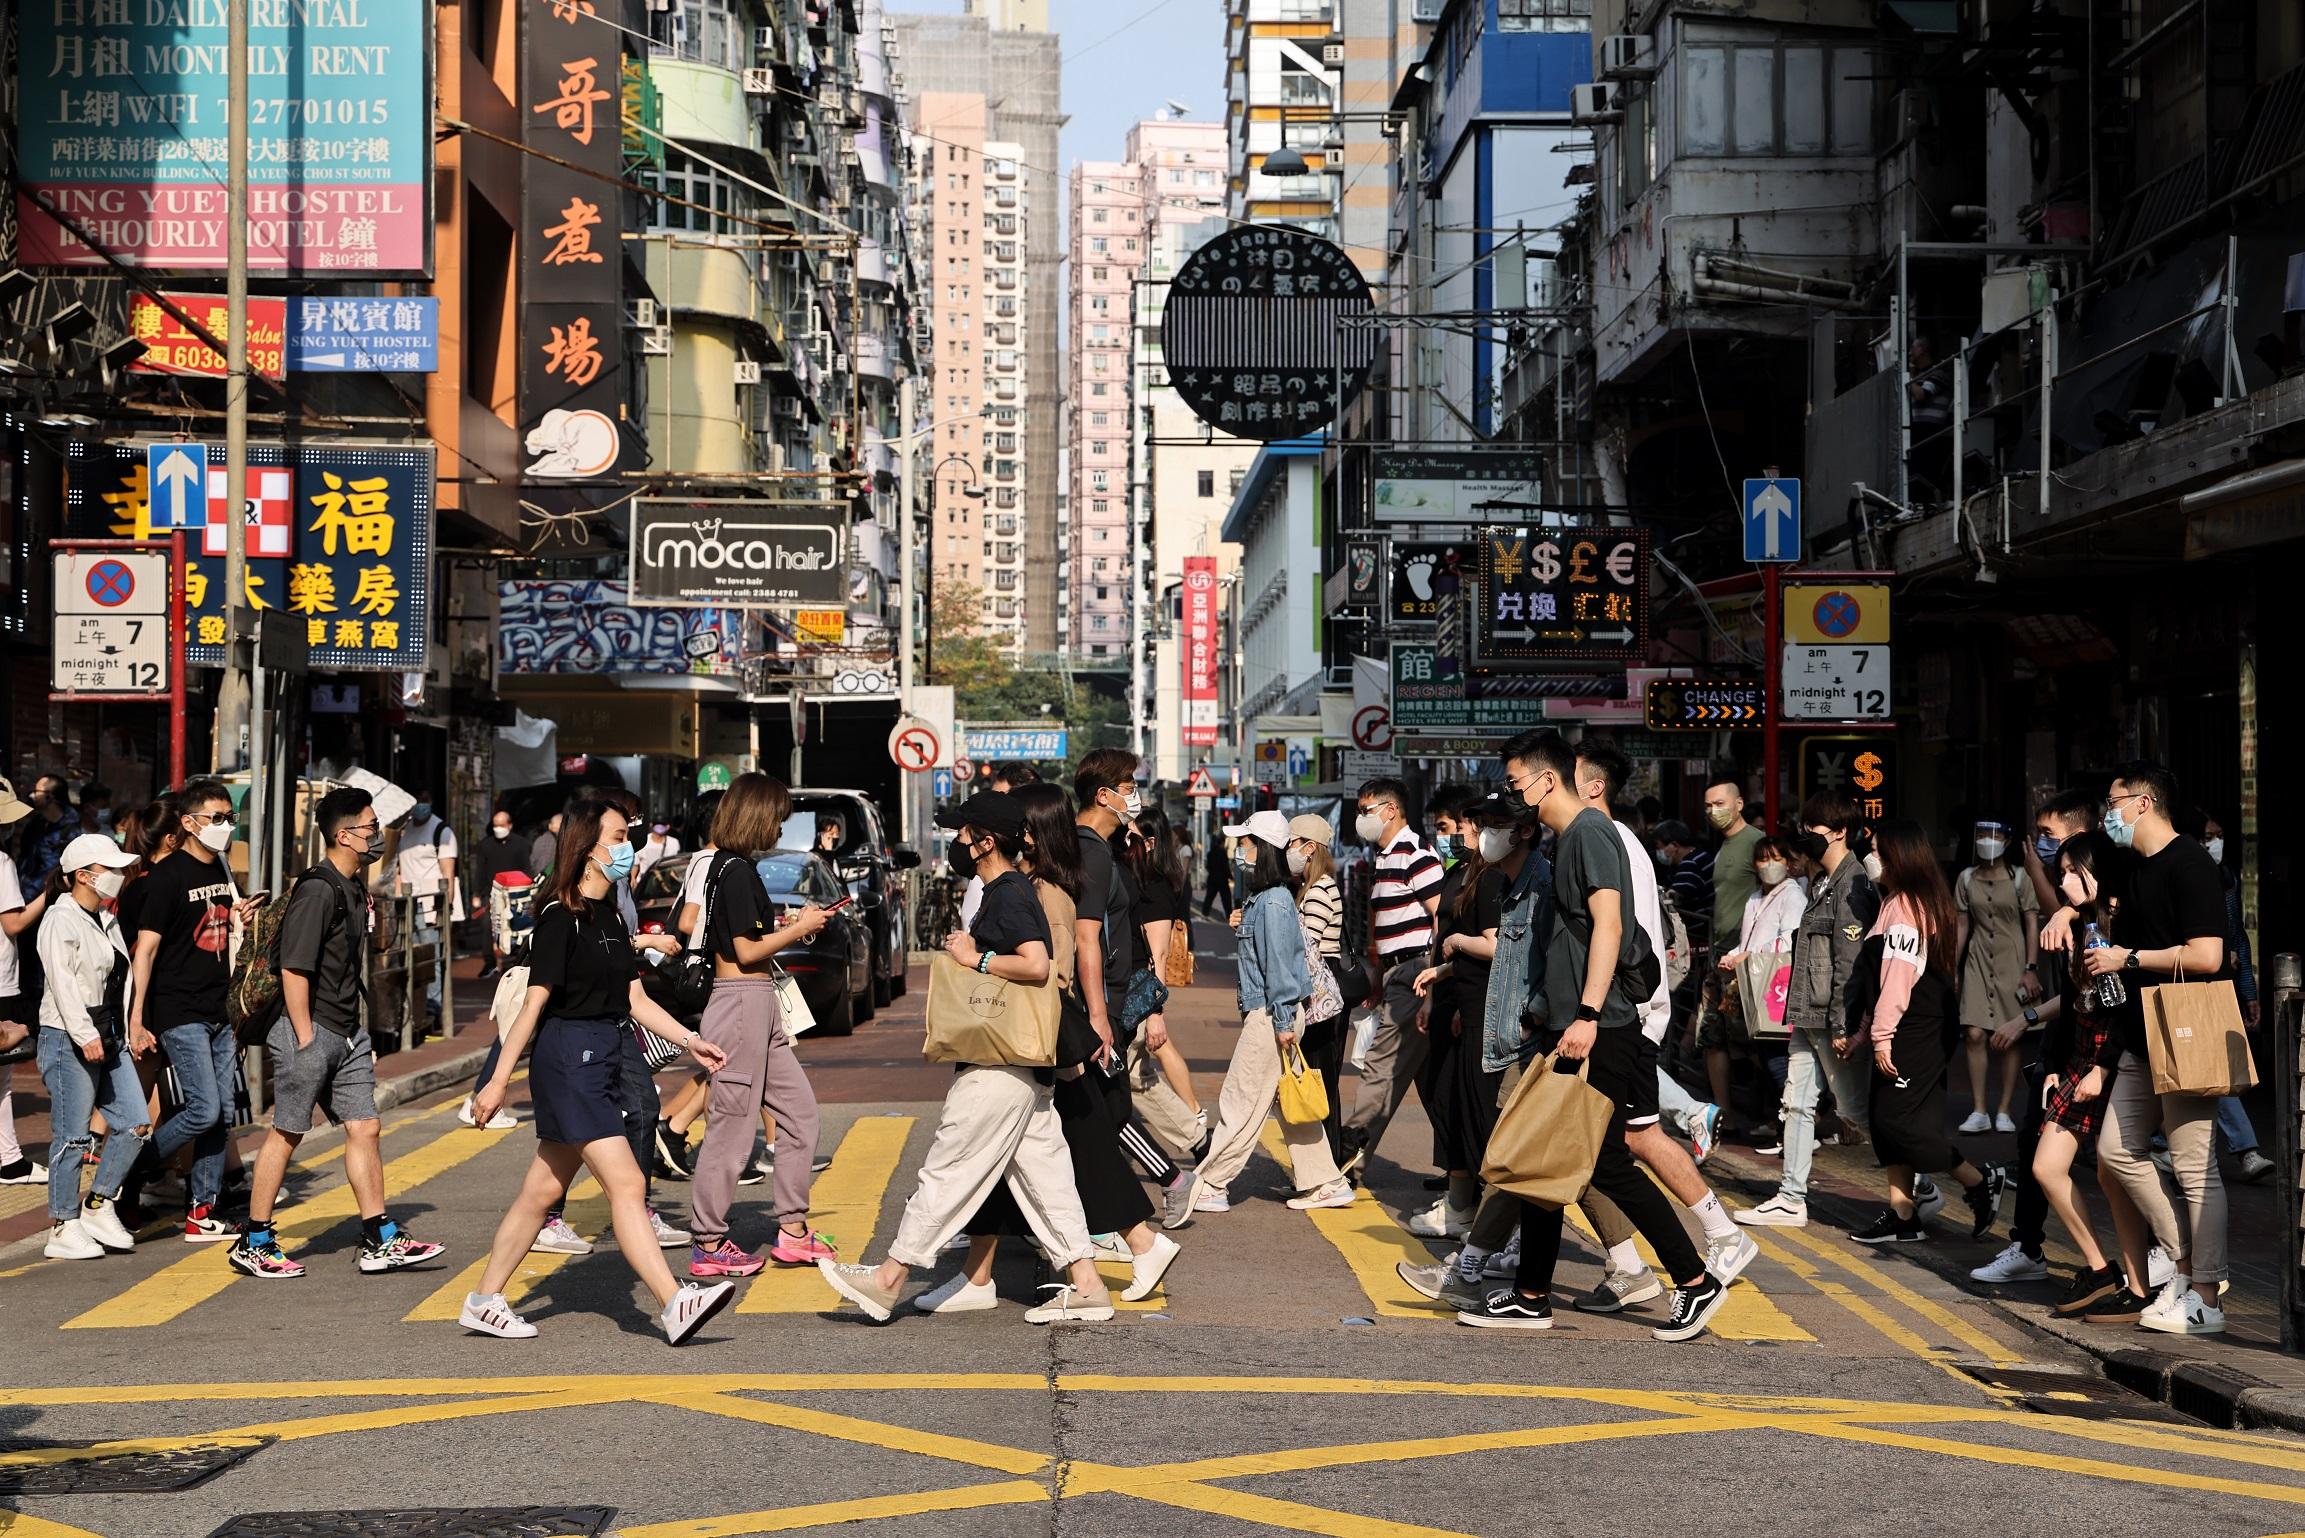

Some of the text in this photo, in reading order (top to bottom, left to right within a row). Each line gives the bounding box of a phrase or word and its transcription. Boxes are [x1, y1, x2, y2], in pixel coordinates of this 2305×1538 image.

[53, 0, 134, 27] 日租
[145, 0, 367, 27] DAILY RENTAL
[48, 36, 133, 77] 月租
[311, 47, 390, 75] RENT
[47, 89, 119, 127] 上網
[126, 94, 198, 124] WIFI
[255, 99, 388, 125] 27701015
[49, 167, 73, 179] 10/F
[75, 167, 108, 179] YUEN
[110, 167, 140, 179] KING
[143, 167, 197, 179] BUILDING
[261, 167, 301, 179] YEUNG
[303, 167, 334, 179] CHOI
[336, 167, 350, 179] ST
[352, 167, 391, 179] SOUTH
[36, 189, 403, 214] SING YUET HOSTEL
[100, 220, 224, 248] HOURLY
[339, 216, 378, 250] 鐘
[291, 336, 431, 349] SING YUET HOSTEL
[353, 351, 420, 370] 按10字樓
[309, 471, 396, 557] 福
[657, 540, 825, 570] moca hair
[1531, 541, 1561, 584] $
[1569, 541, 1598, 584] £
[1605, 542, 1636, 585] €
[715, 577, 764, 585] We love hair
[680, 590, 733, 598] appointment
[1420, 602, 1436, 613] 23
[81, 619, 99, 628] am
[126, 621, 143, 645] 7
[74, 631, 106, 645] 上午
[61, 658, 119, 670] midnight
[1398, 649, 1435, 681] 館
[1804, 661, 1832, 673] 上午
[1852, 651, 1869, 674] 7
[73, 672, 106, 686] 午夜
[128, 663, 158, 687] 12
[1397, 685, 1465, 698] REGEN
[1685, 690, 1756, 703] CHANGE
[1790, 687, 1846, 700] midnight
[1853, 690, 1885, 713] 12
[1804, 701, 1832, 714] 午夜
[1443, 740, 1451, 749] &
[1454, 740, 1487, 749] BODY
[1853, 751, 1883, 791] $
[968, 996, 1007, 1008] La viva
